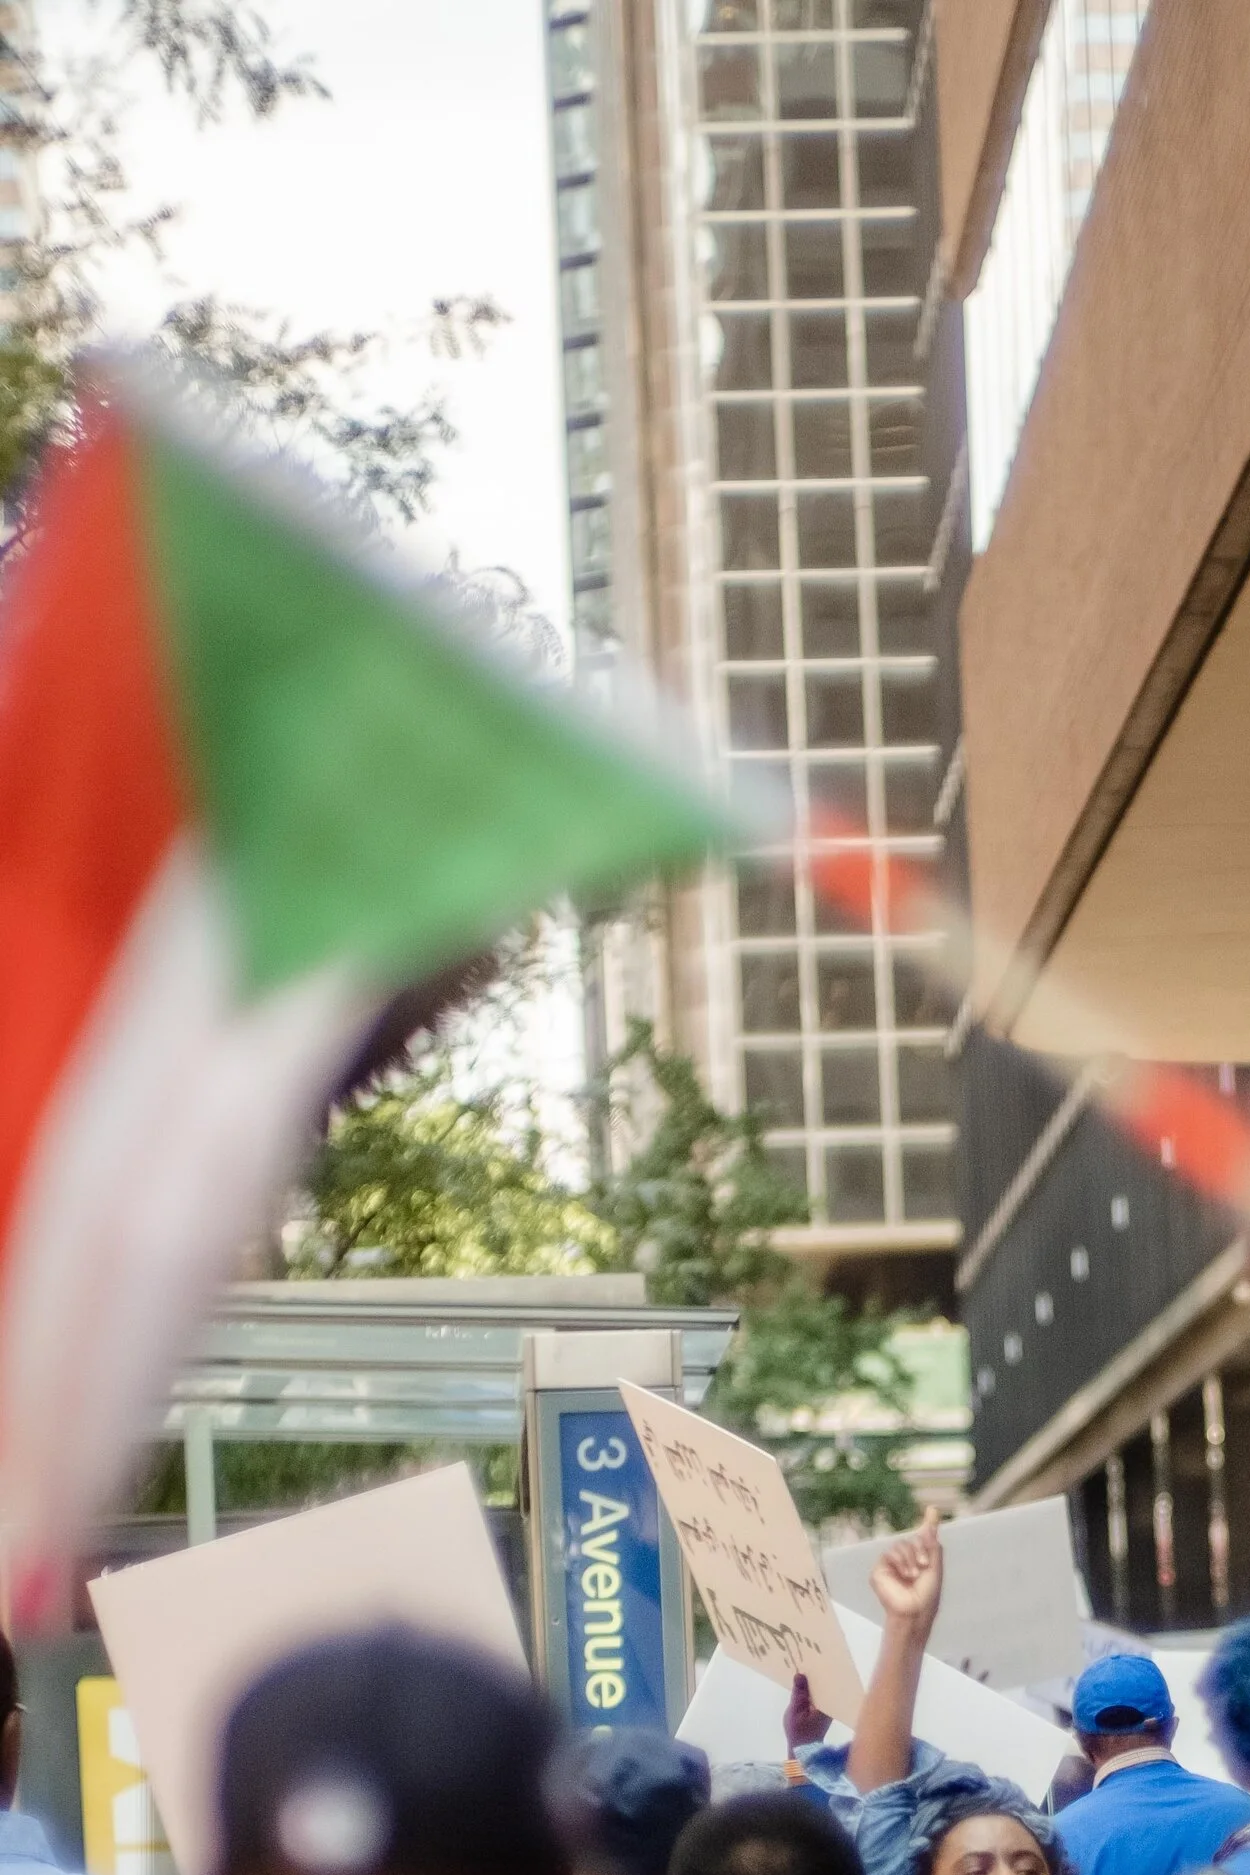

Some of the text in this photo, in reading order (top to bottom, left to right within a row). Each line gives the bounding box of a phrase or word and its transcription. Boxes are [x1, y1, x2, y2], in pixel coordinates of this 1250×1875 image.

[577, 1436, 627, 1472] 3
[579, 1489, 631, 1710] Avenue
[706, 1587, 737, 1644] لا
